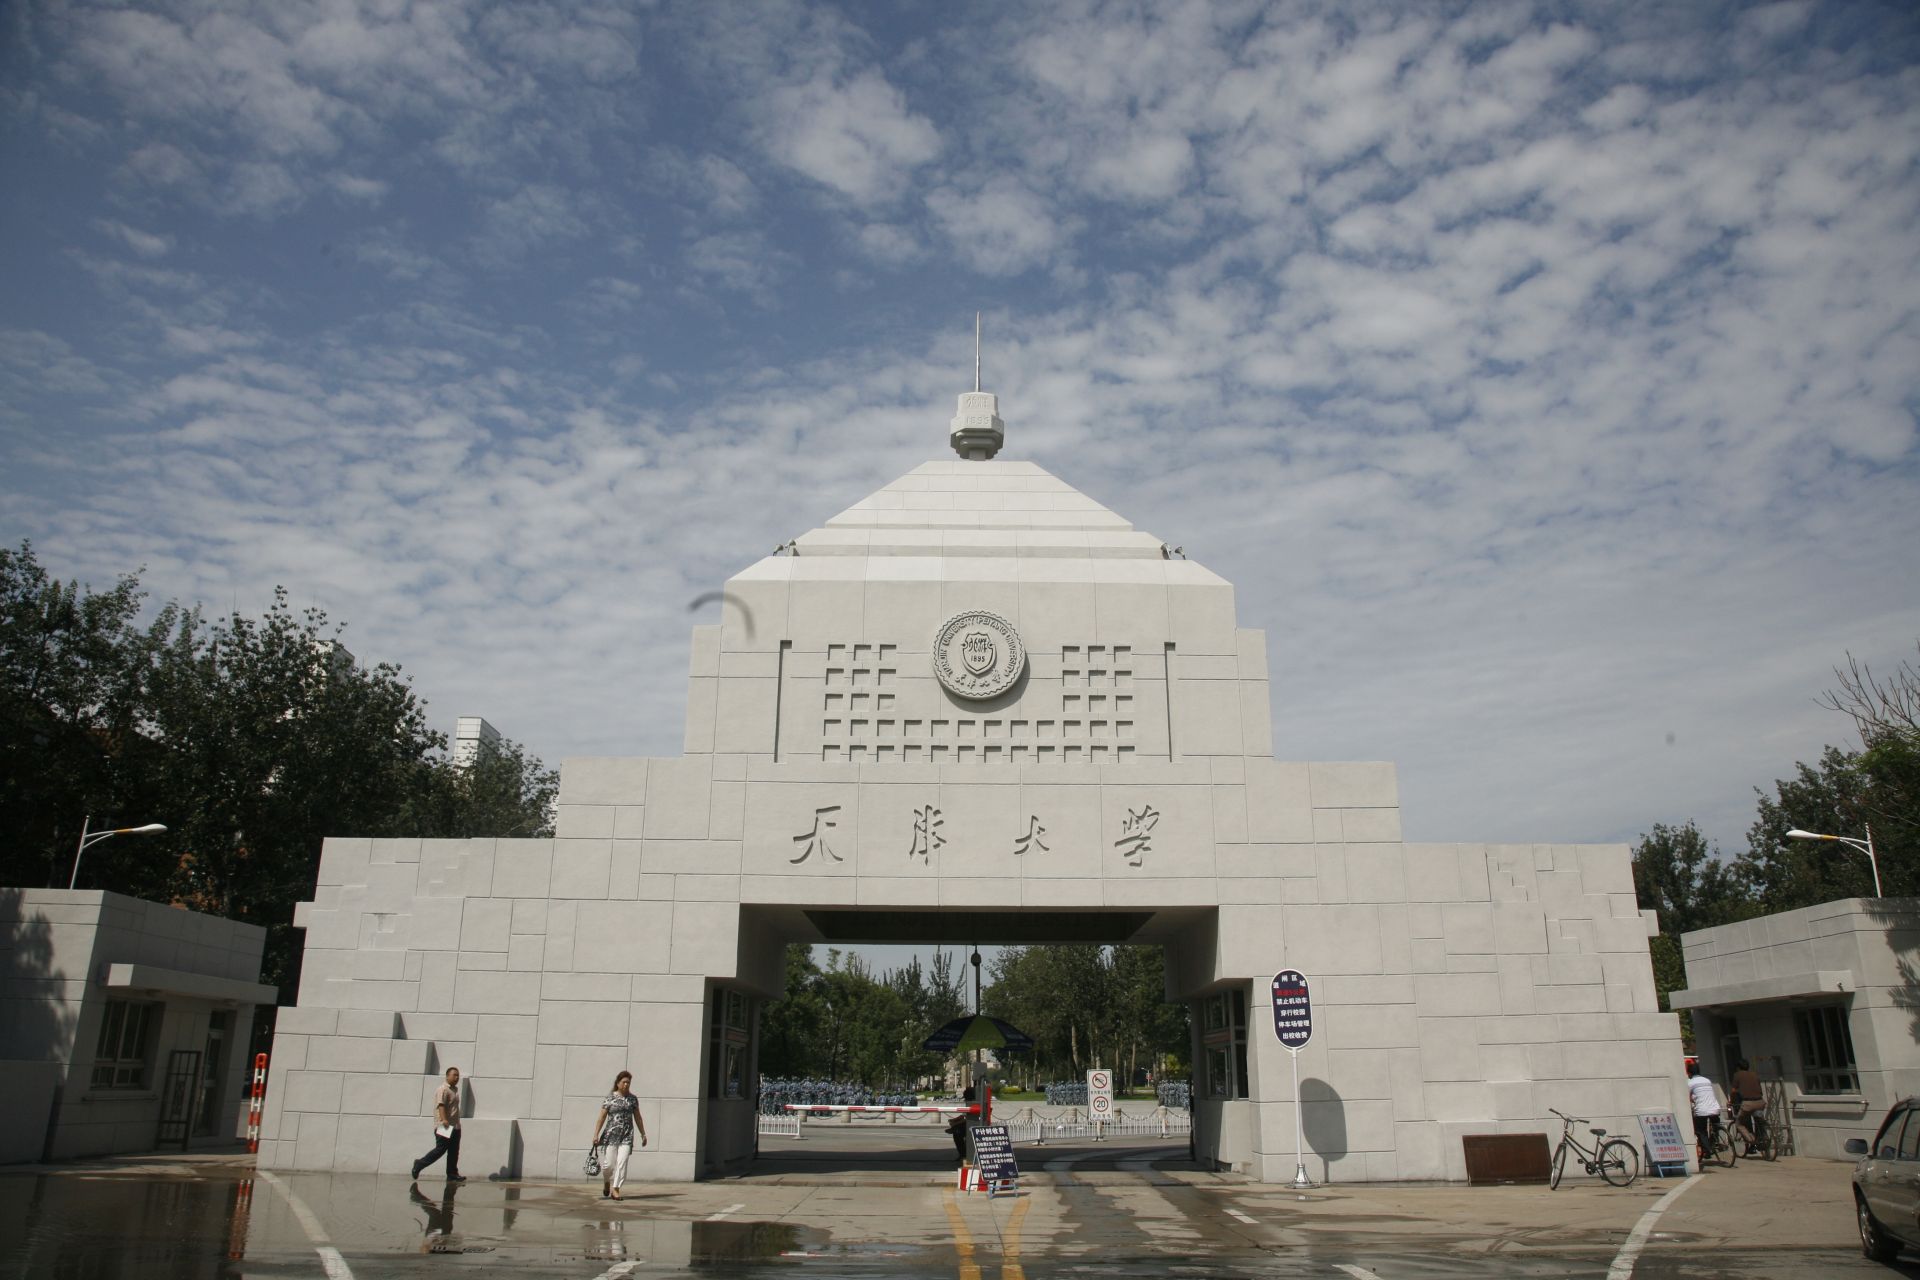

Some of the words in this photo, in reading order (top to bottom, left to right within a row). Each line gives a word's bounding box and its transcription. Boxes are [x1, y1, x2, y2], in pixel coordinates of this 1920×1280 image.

[943, 617, 976, 646] UNIVERSITY
[789, 804, 1161, 868] 天津大学
[1279, 1020, 1310, 1028] 停车场管理
[1096, 1100, 1105, 1108] 20
